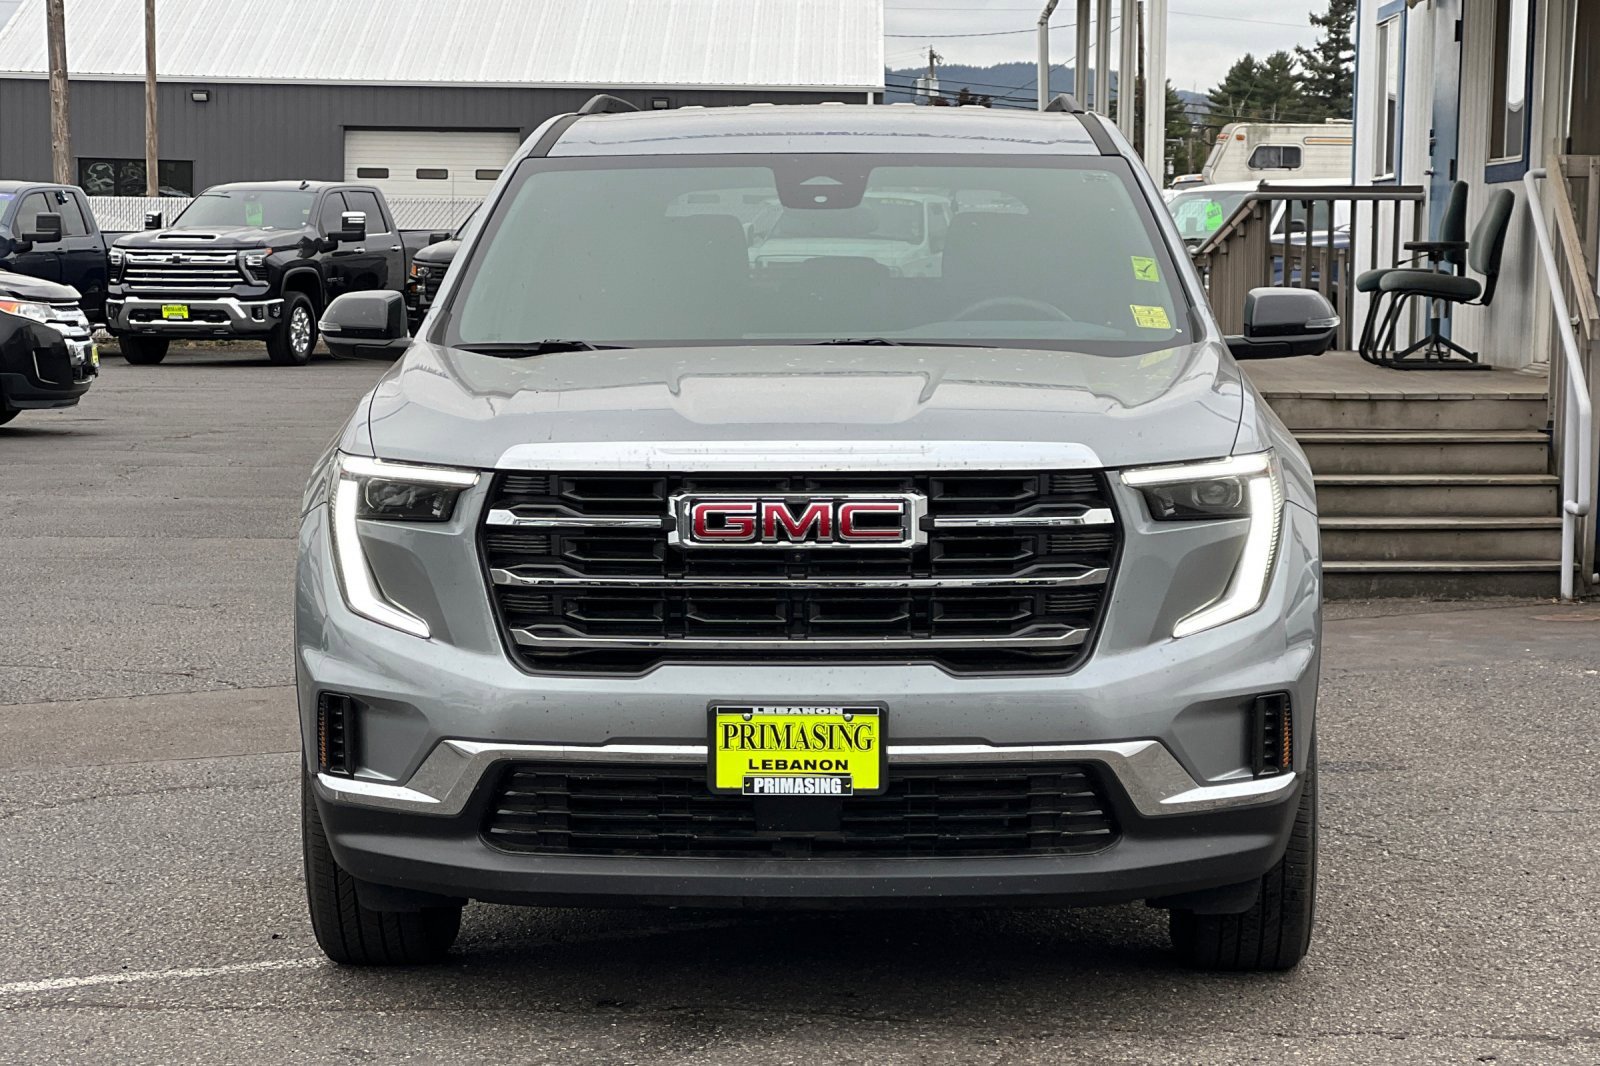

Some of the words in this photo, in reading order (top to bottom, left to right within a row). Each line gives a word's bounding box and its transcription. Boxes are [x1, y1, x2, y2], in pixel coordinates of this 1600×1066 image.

[692, 502, 904, 541] GMC
[752, 707, 843, 715] LEBANON
[720, 722, 874, 752] PRIMASING
[748, 759, 848, 771] LEBANON
[754, 778, 841, 794] PRIMASING
